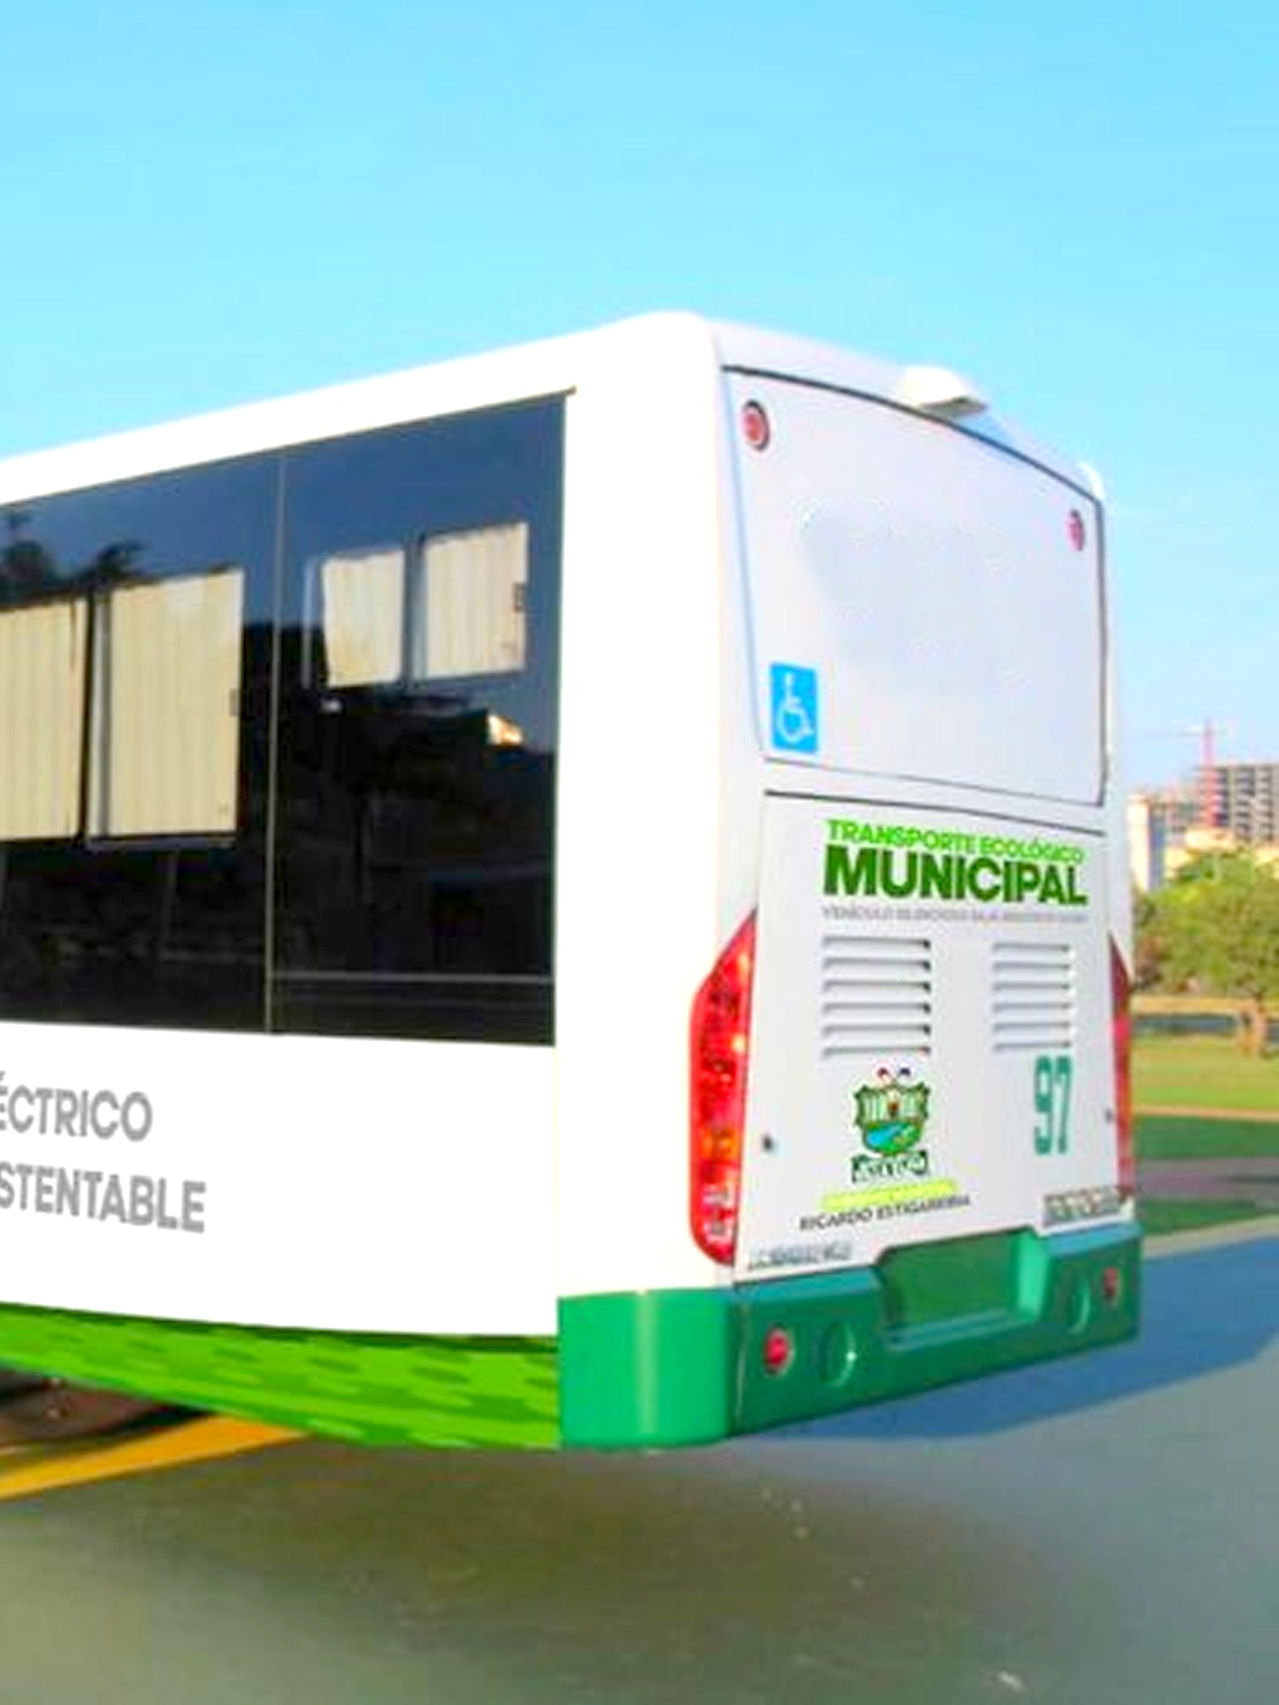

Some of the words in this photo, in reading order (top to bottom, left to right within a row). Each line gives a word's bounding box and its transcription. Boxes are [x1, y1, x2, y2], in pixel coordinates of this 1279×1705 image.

[827, 819, 975, 855] TRANSPORTE
[823, 844, 1087, 905] MUNICIPAL
[1035, 1055, 1072, 1155] 97
[799, 1208, 871, 1231] RICARDO
